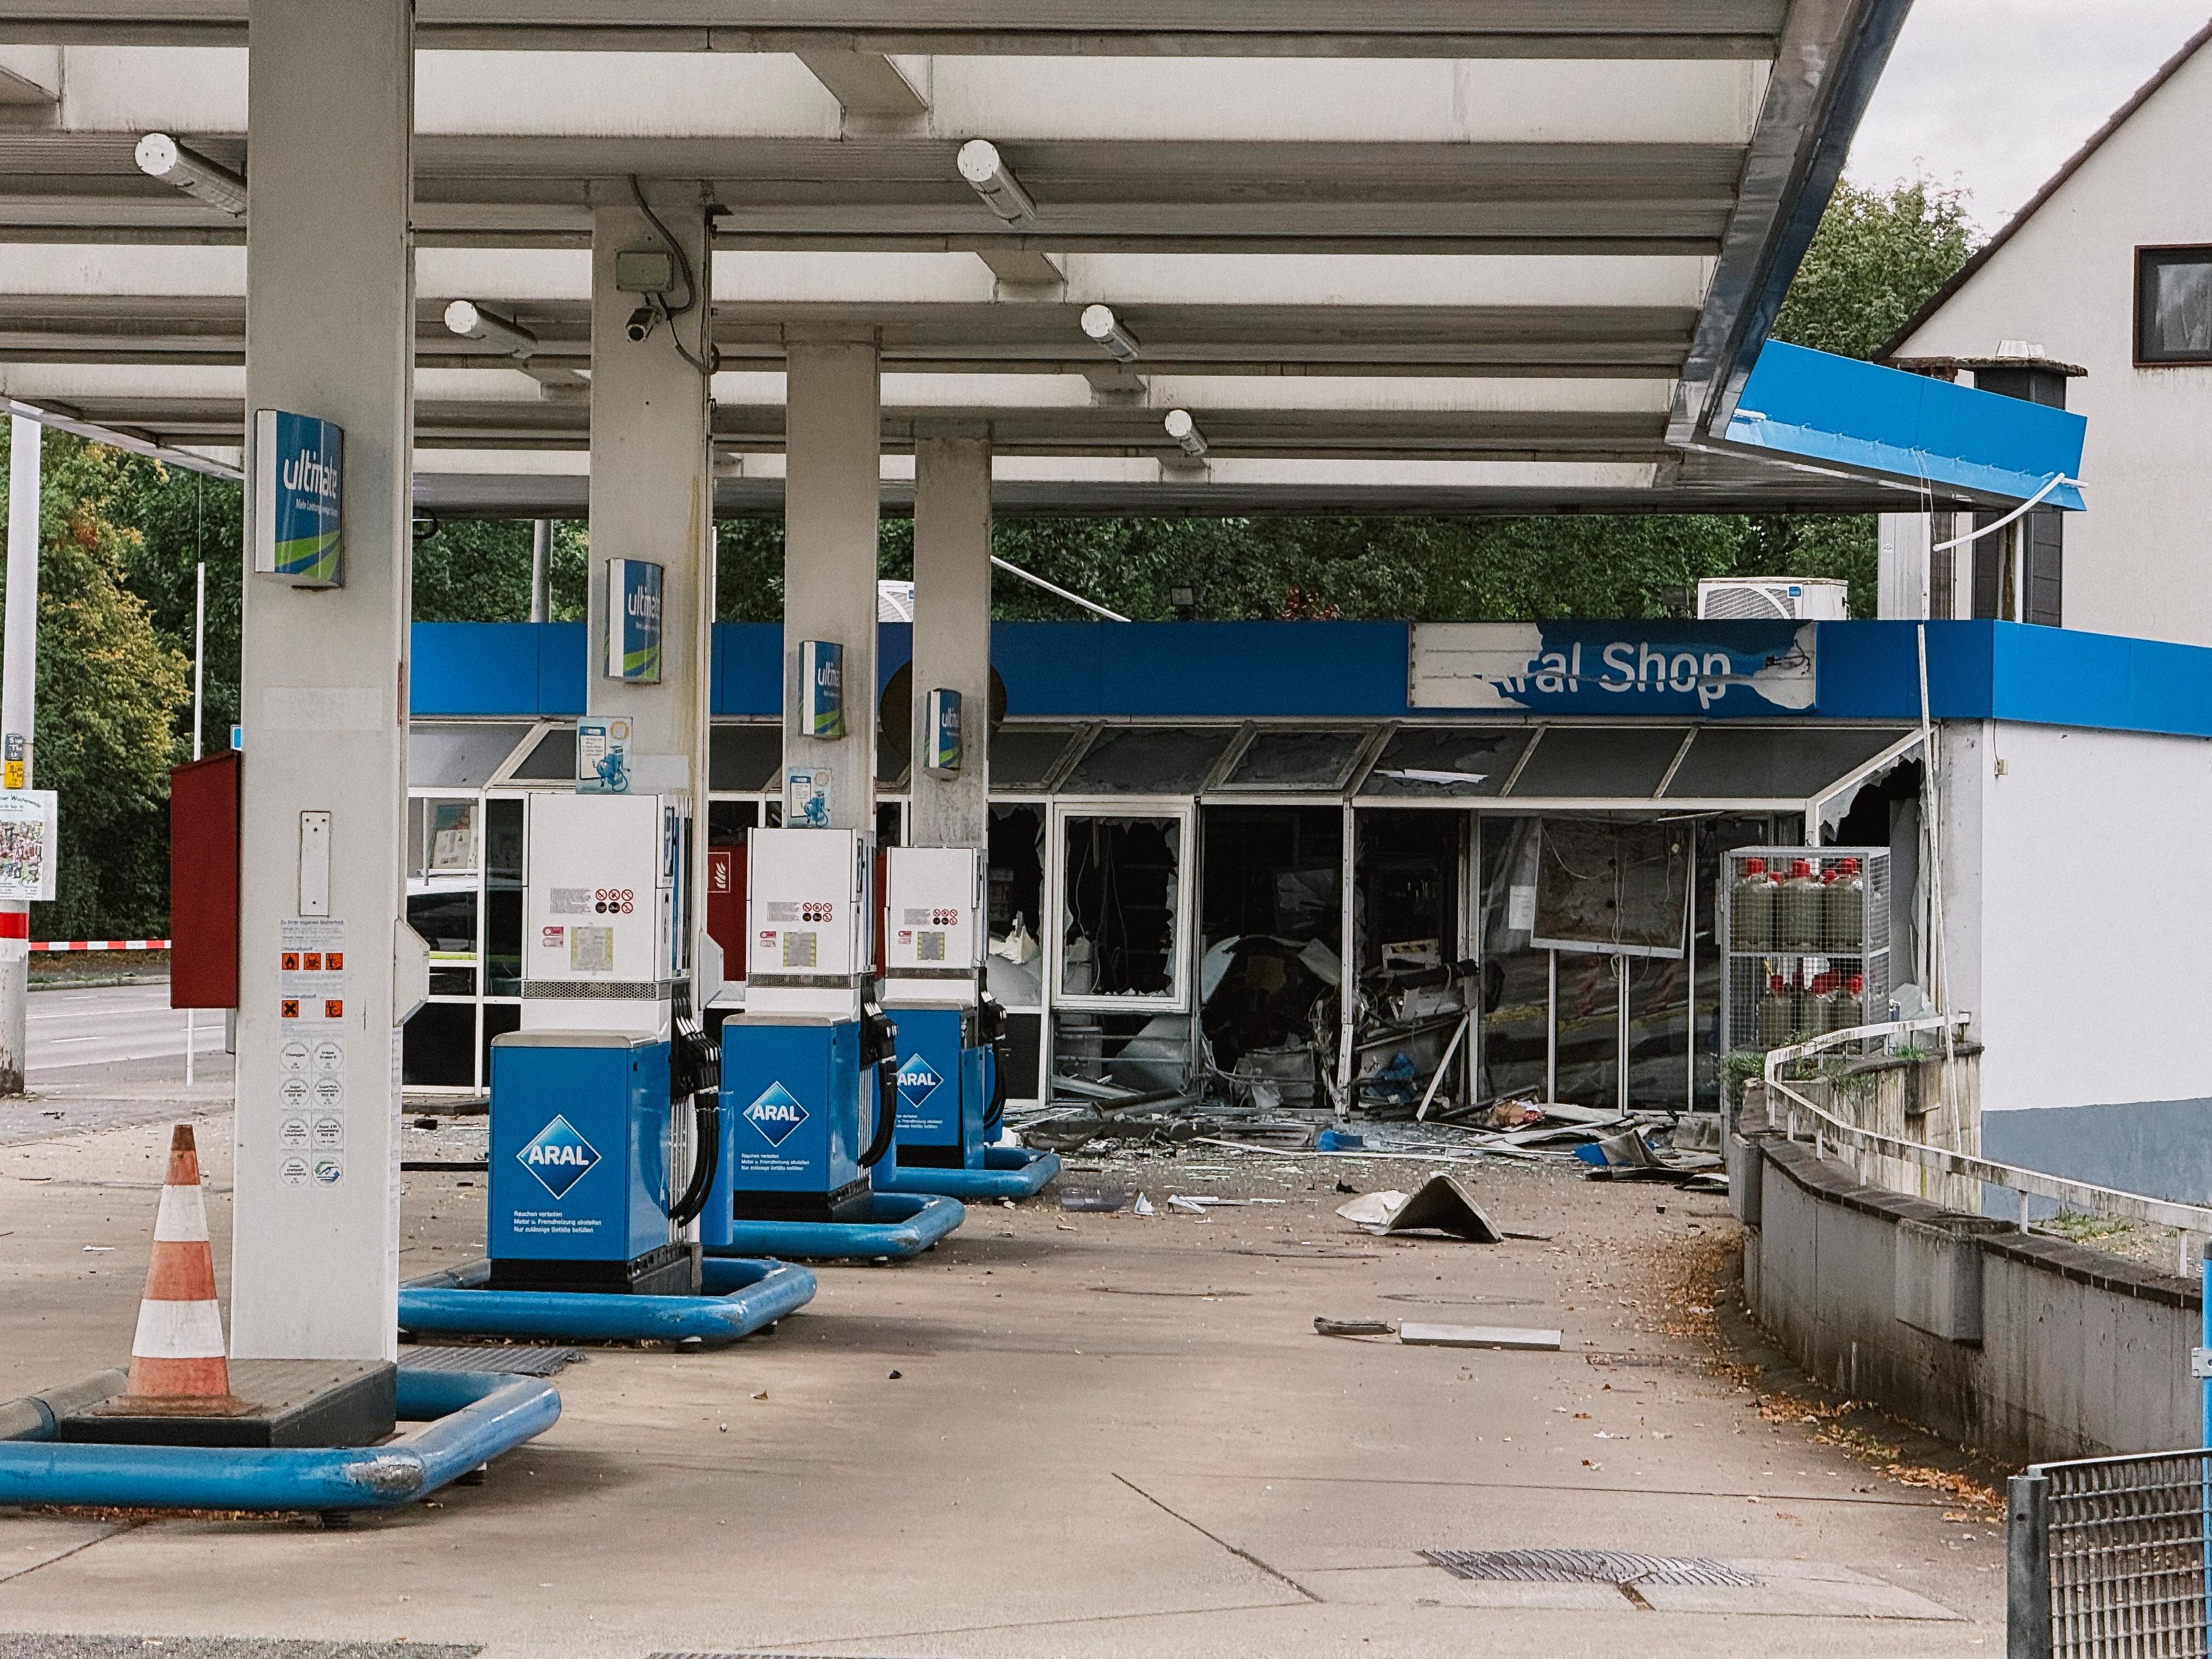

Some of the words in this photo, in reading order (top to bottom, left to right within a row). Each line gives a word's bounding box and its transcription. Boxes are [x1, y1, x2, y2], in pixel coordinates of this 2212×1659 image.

[284, 449, 338, 499] ultimate
[1598, 642, 1731, 709] Shop
[897, 1073, 936, 1086] ARAL
[752, 1105, 800, 1121] ARAL
[528, 1145, 589, 1166] ARAL
